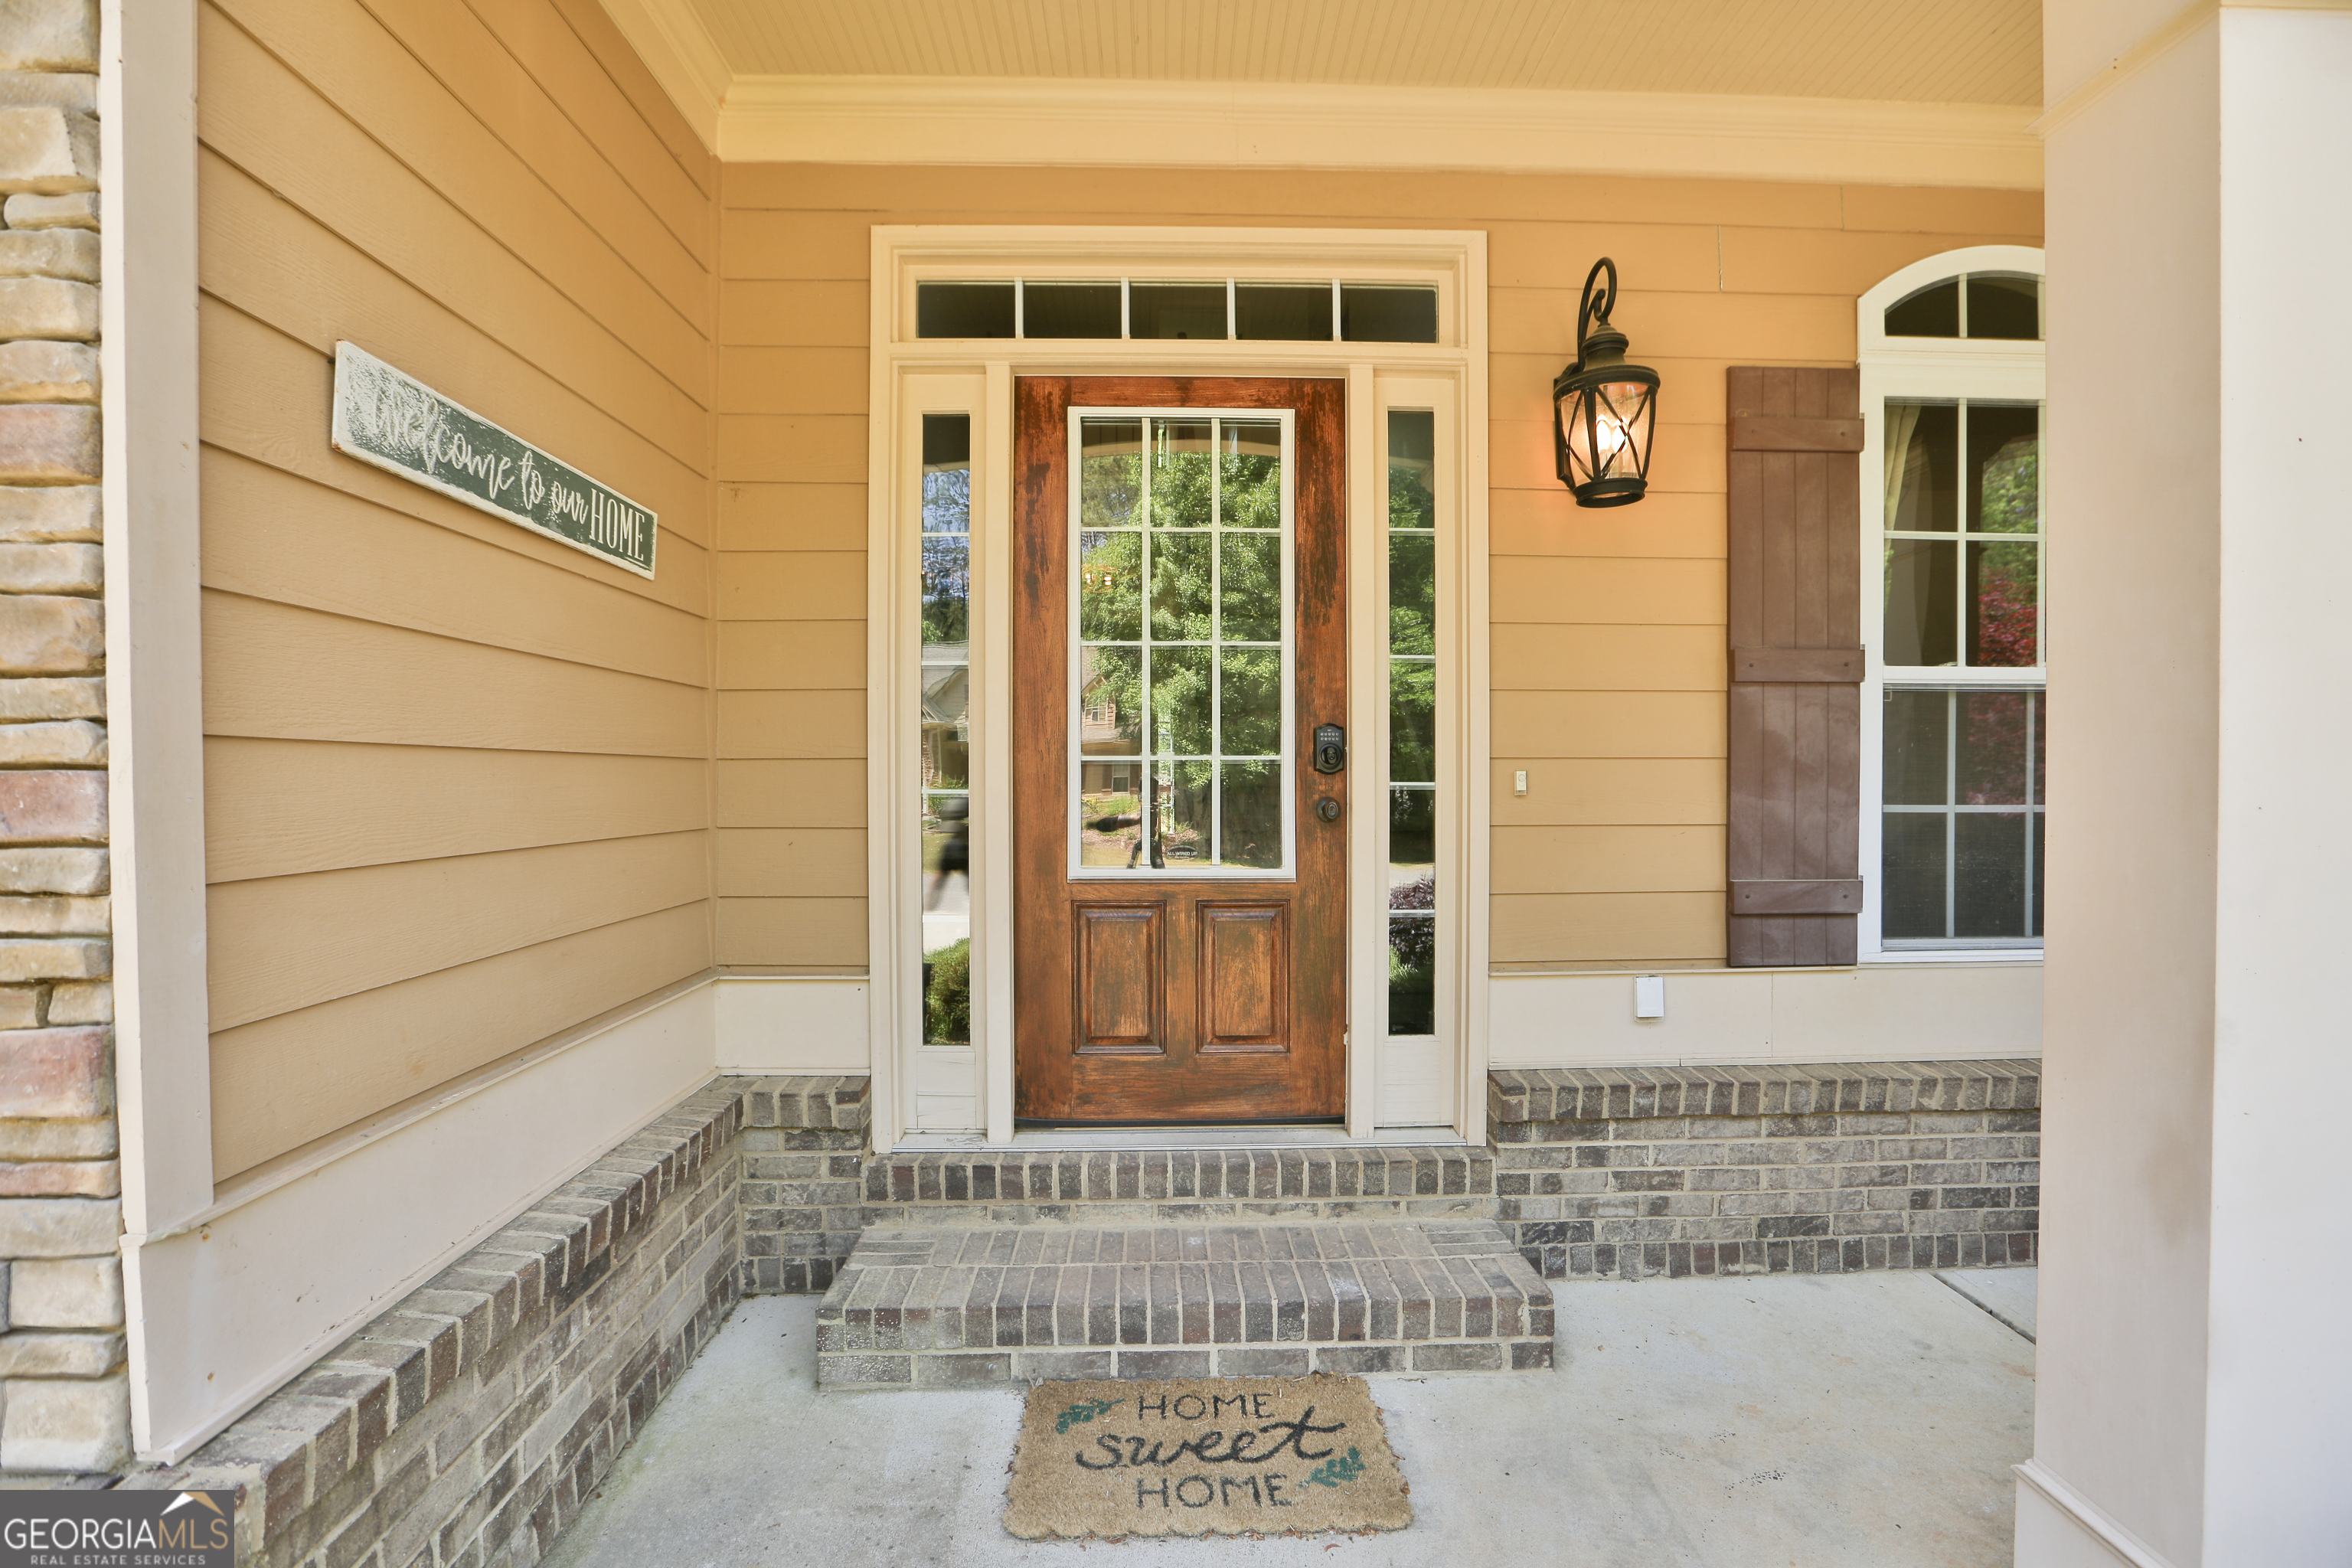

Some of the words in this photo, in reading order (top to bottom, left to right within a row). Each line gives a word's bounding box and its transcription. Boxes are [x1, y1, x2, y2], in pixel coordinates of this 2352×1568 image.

[375, 388, 515, 499] Welcome
[518, 450, 545, 511] to
[552, 481, 589, 525] our
[589, 488, 645, 562] HOME
[1138, 1393, 1273, 1420] HOME
[1076, 1406, 1346, 1470] sweet
[1137, 1473, 1292, 1508] HOME
